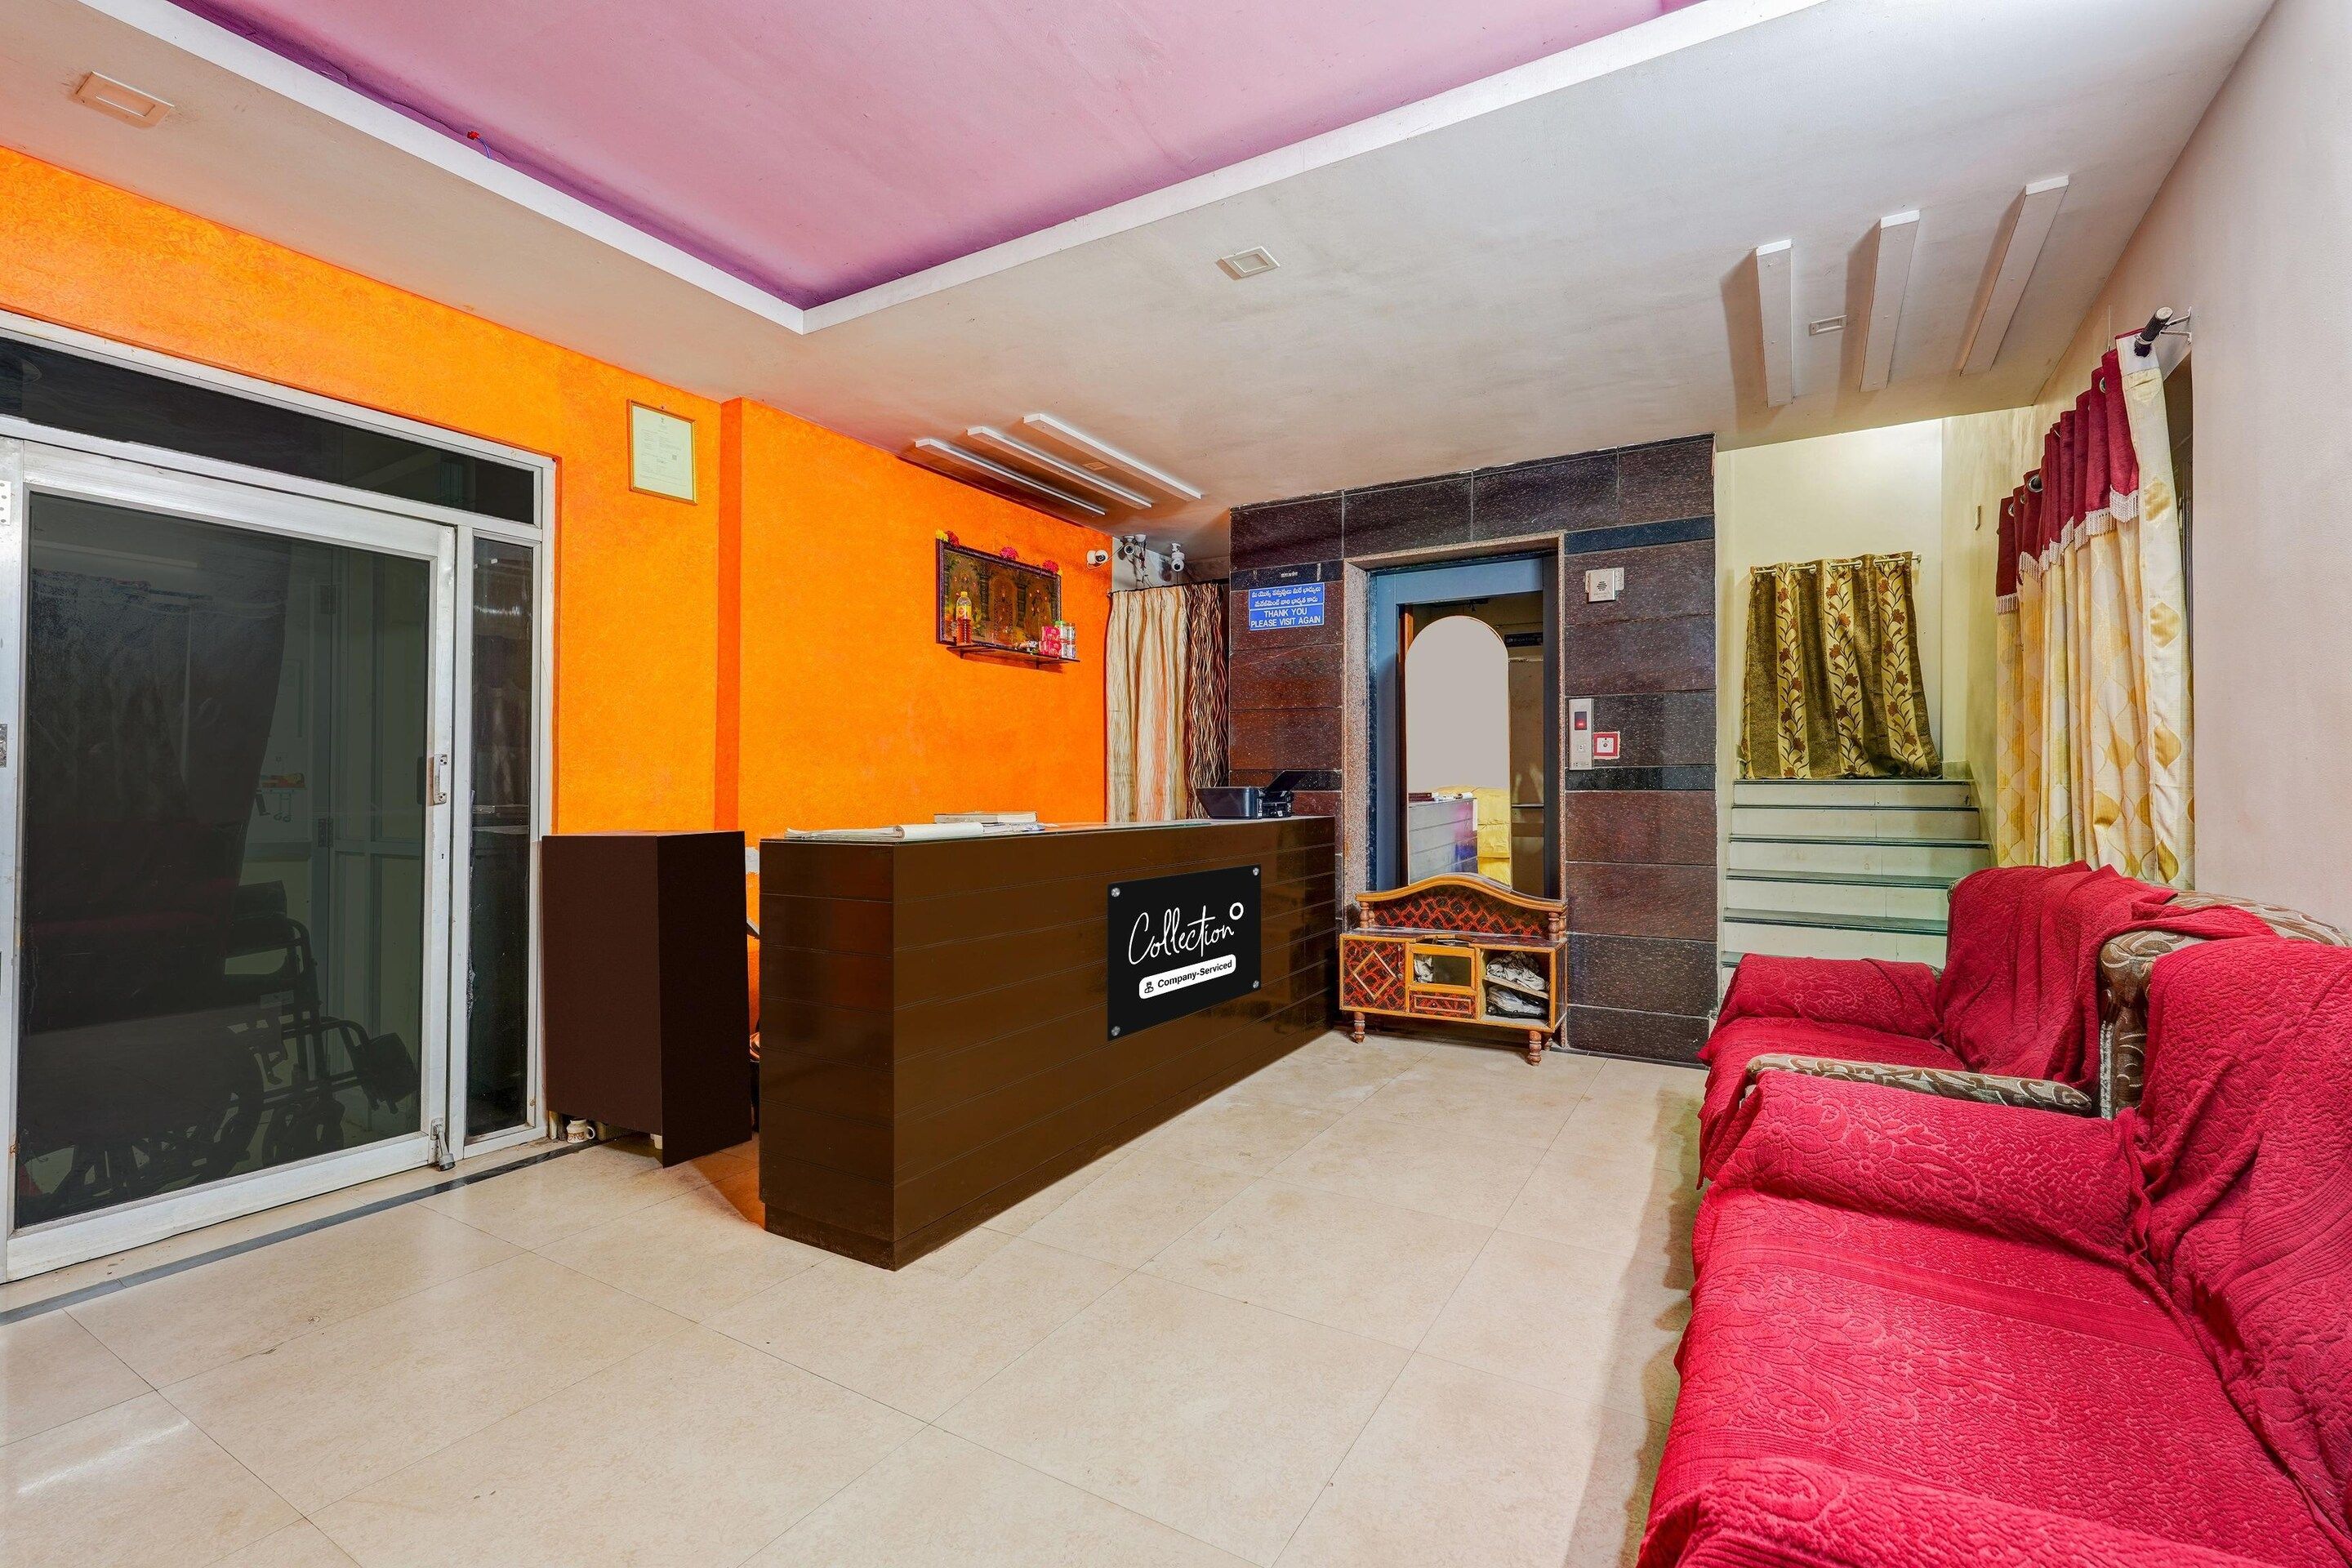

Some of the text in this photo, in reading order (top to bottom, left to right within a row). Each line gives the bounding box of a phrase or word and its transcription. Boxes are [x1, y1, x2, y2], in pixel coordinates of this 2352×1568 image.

[1250, 616, 1321, 628] PLEASE VISIT AGAIN
[1264, 608, 1307, 618] THANK YOU
[1128, 905, 1235, 965] Collection
[1157, 960, 1232, 988] Company-Serviced
